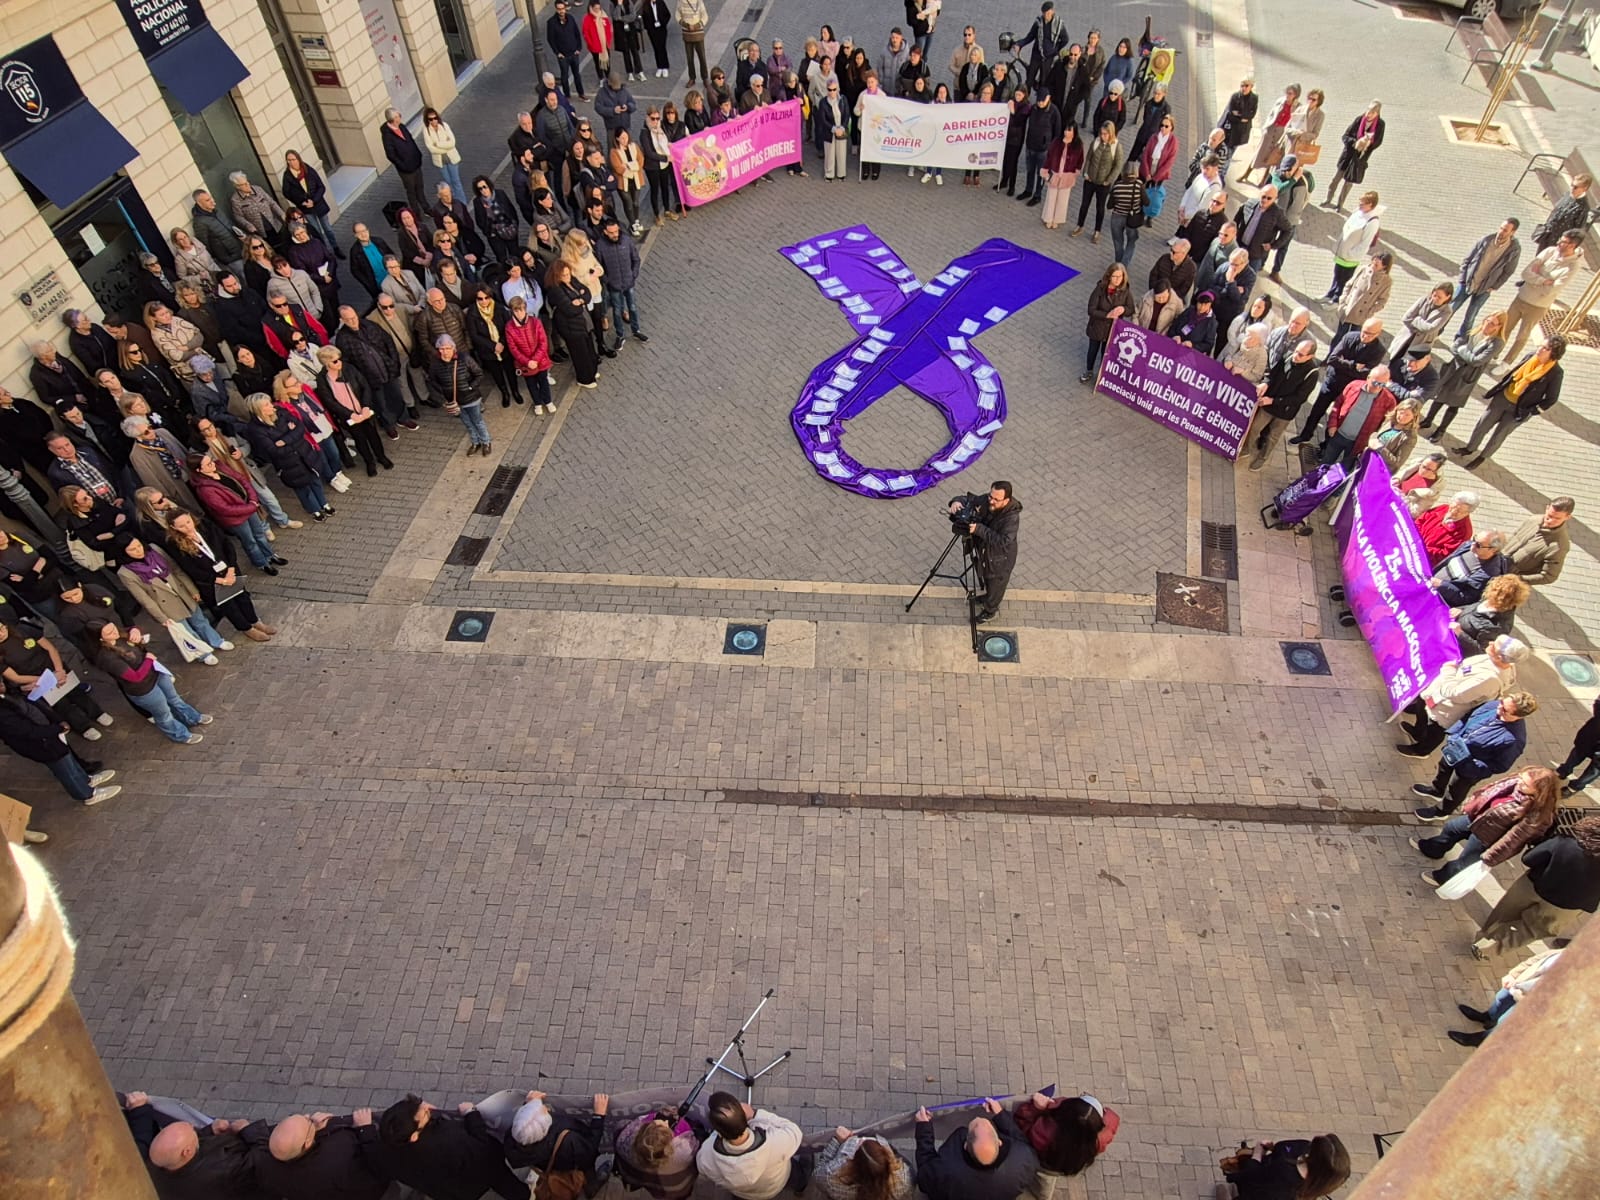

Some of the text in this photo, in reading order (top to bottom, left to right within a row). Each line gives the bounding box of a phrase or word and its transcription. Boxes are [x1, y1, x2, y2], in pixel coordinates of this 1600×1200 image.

[140, 0, 188, 32] NACIONAL
[15, 84, 35, 103] 115
[942, 116, 1008, 131] ABRIENDO
[946, 130, 1005, 144] CAMINOS
[726, 139, 755, 162] DONES,
[883, 136, 922, 148] ADAFIR
[732, 140, 796, 179] NI UN PAS ENRERE
[1105, 360, 1120, 376] NO
[1120, 370, 1128, 381] A
[1128, 372, 1140, 389] LA
[1143, 380, 1190, 411] VIOLÈNCIA
[1192, 403, 1206, 418] DE
[1206, 411, 1243, 440] GÈNERE
[1148, 352, 1256, 418] ENS VOLEM VIVES
[1100, 377, 1236, 456] Associació Unió per les Pensions Alzira
[1357, 528, 1369, 550] LA
[1362, 543, 1399, 614] VIOLÈNCIA
[1396, 610, 1427, 688] MASCLISTA
